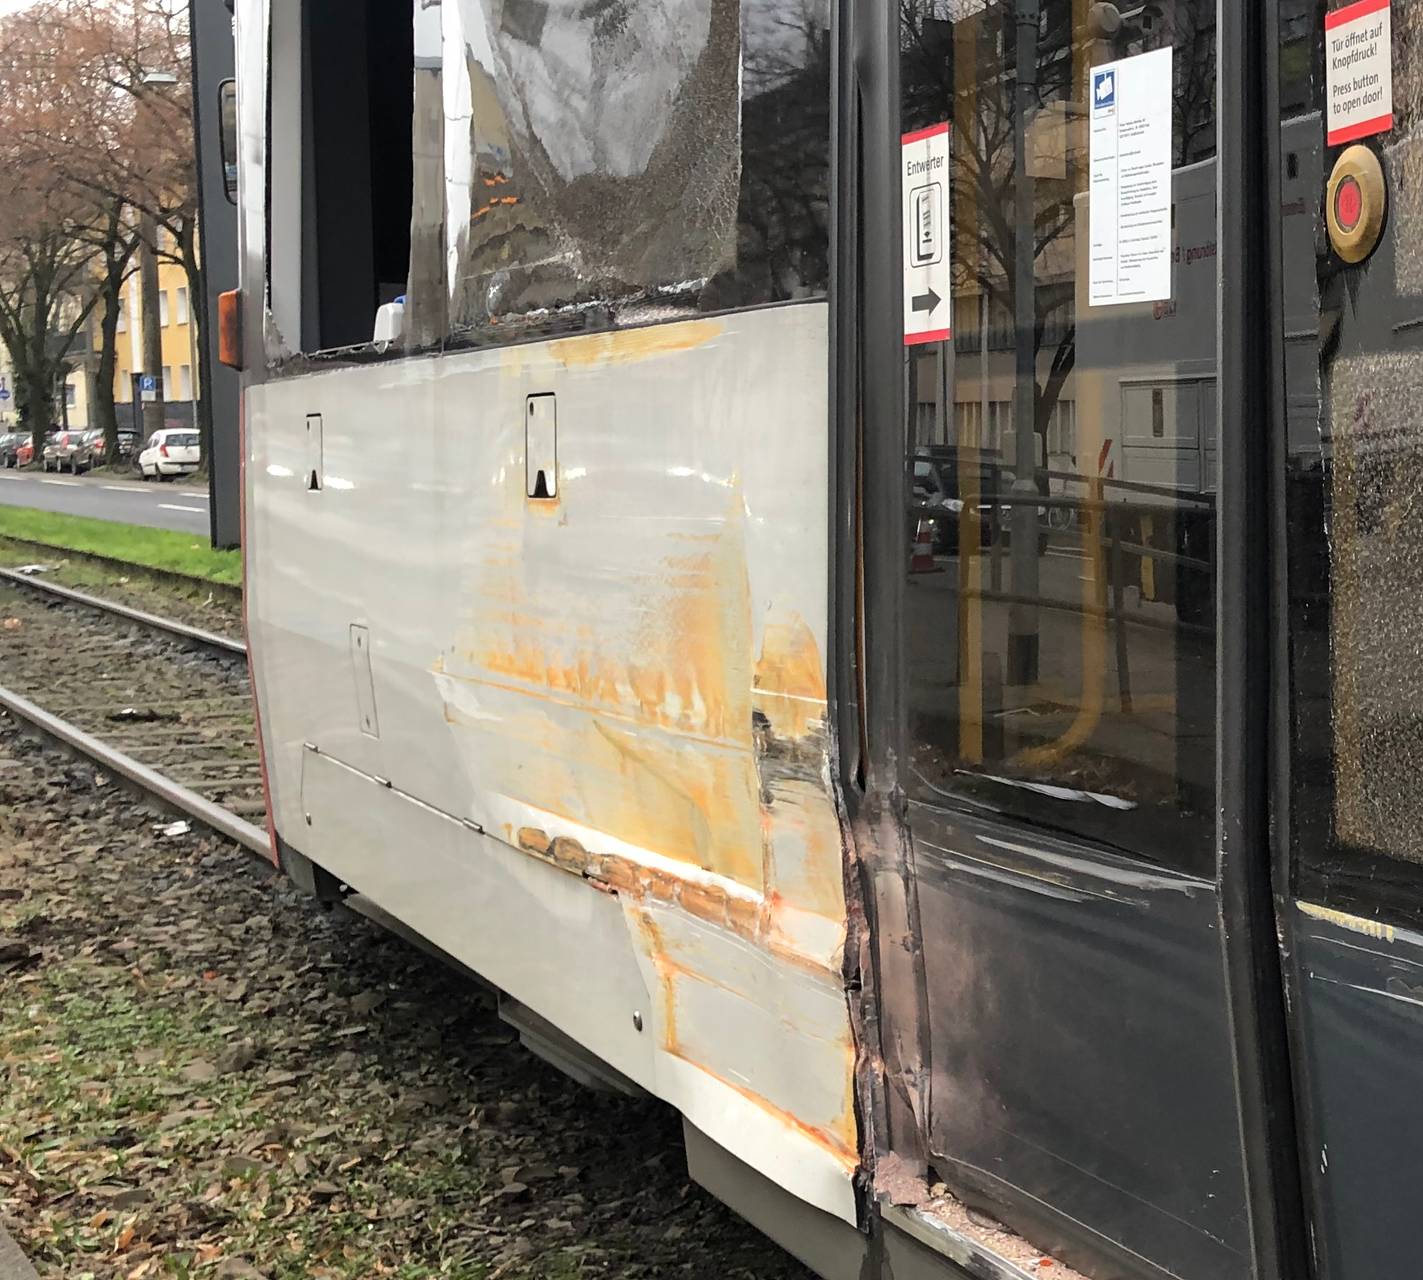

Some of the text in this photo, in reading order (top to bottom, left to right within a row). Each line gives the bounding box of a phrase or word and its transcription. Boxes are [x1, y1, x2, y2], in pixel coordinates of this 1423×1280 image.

[1331, 22, 1383, 53] Tür öffnet auf
[1332, 42, 1377, 70] Knopfdruck!
[1333, 73, 1379, 98] Press button
[1333, 86, 1383, 115] to open door!
[907, 155, 944, 176] Entwerter
